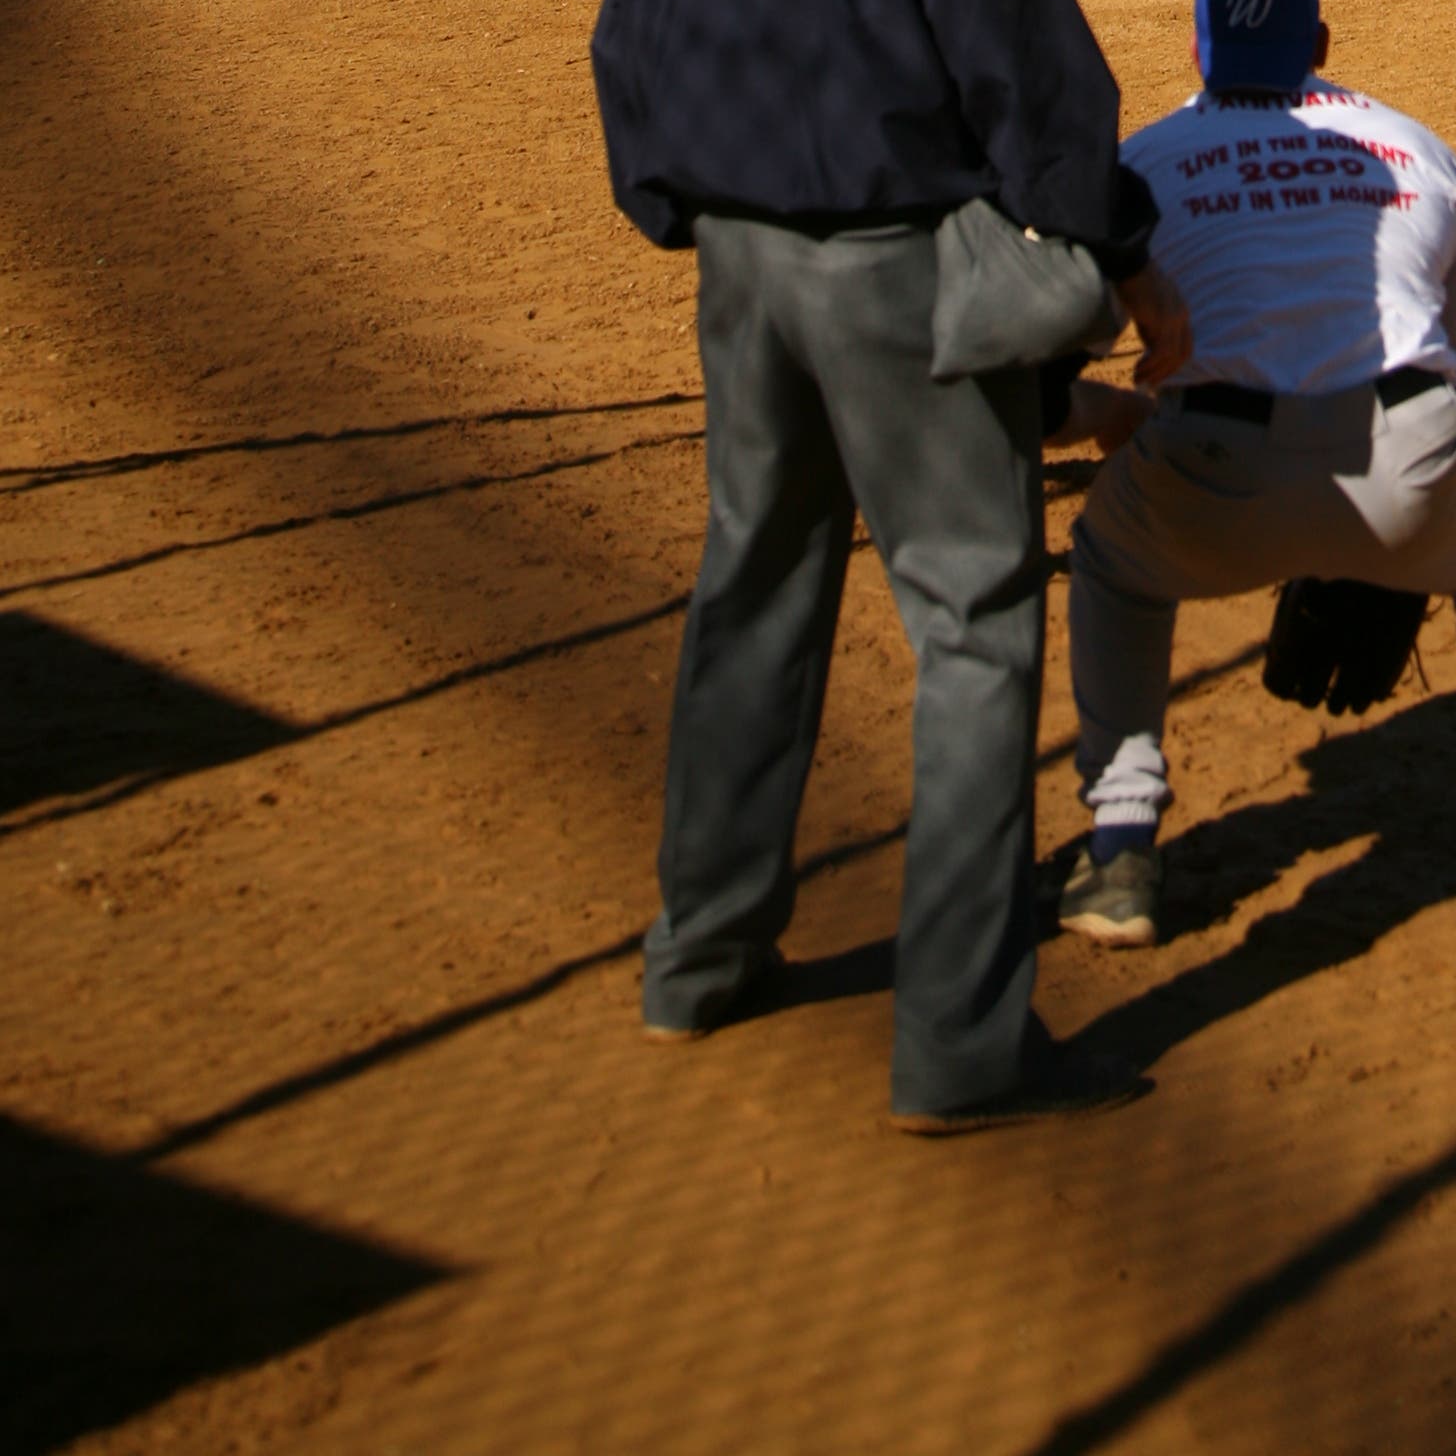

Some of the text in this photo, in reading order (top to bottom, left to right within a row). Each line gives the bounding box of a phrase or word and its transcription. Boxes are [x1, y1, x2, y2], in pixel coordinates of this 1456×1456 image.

[1237, 140, 1260, 159] IN
[1267, 136, 1308, 153] THE
[1237, 157, 1366, 185] 2009
[1249, 194, 1274, 212] IN
[1279, 188, 1321, 209] THE
